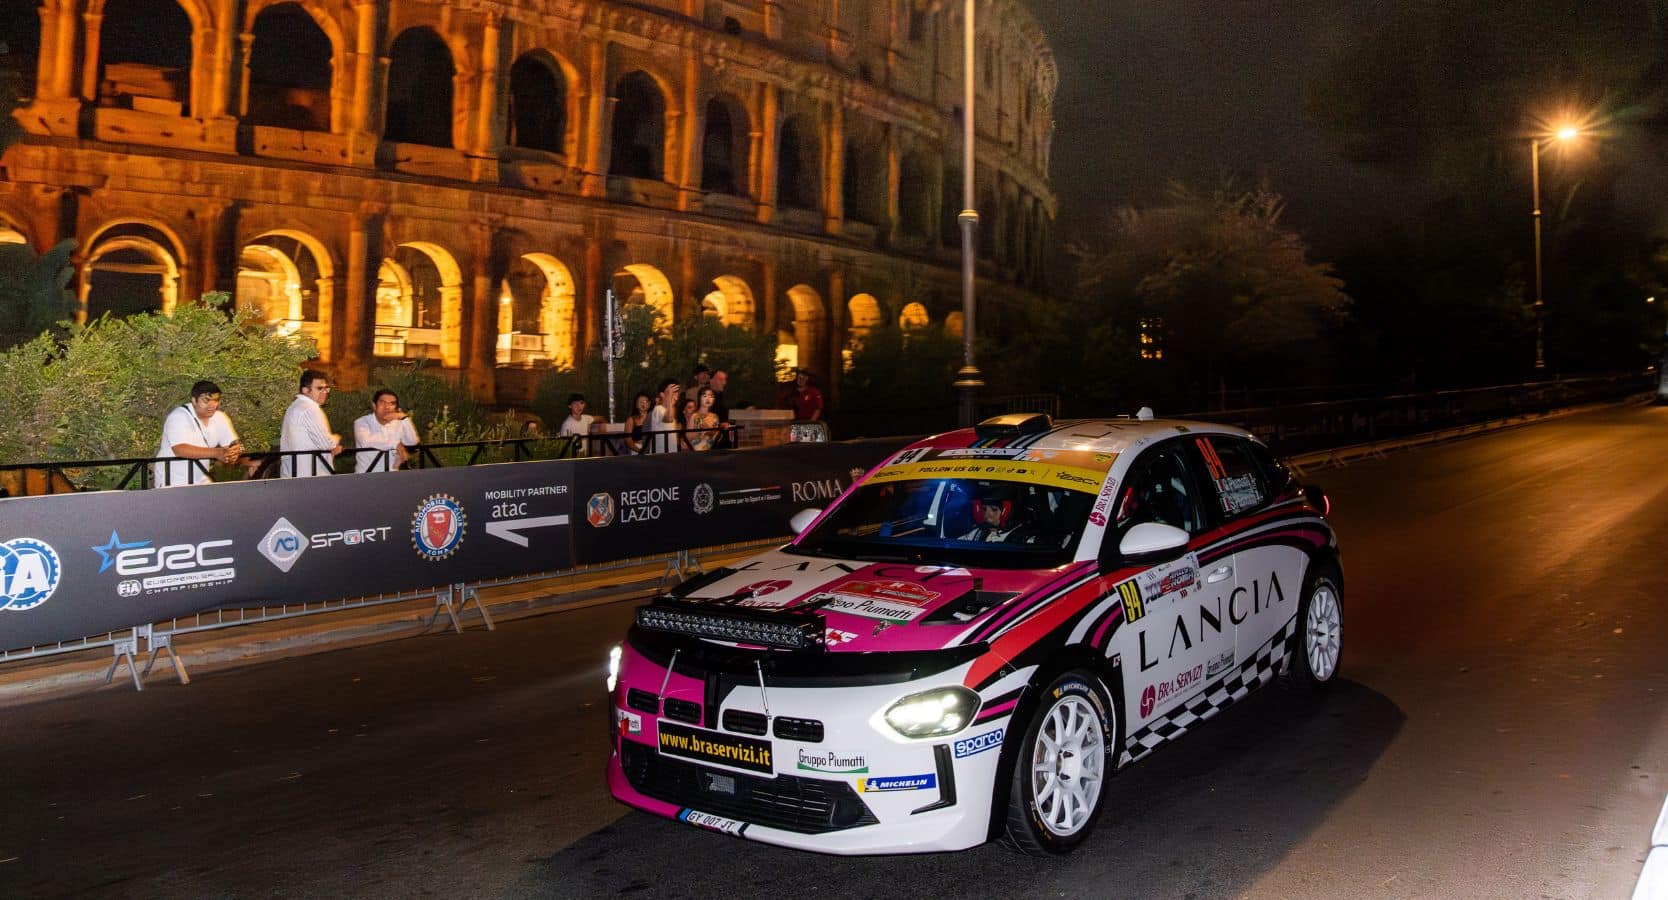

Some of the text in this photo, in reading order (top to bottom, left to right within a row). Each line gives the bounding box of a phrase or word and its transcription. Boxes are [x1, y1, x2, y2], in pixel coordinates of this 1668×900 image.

[485, 485, 568, 501] MOBILITY PARTNER
[620, 486, 680, 506] REGIONE
[791, 479, 843, 502] ROMA
[415, 499, 463, 533] AUTOMOBILE CLUB
[491, 502, 528, 518] atac
[620, 505, 661, 523] LAZIO
[274, 536, 299, 553] ACI
[311, 526, 392, 549] SPORT
[116, 539, 234, 576] ERC
[855, 600, 915, 620] Piumatti
[1119, 581, 1143, 622] 94
[1138, 570, 1285, 672] LANCIA
[1157, 679, 1175, 701] BRA
[1176, 664, 1203, 690] SERVIZI
[659, 731, 771, 766] www.braservizi.it
[956, 730, 1003, 754] sparco
[799, 748, 865, 768] Gruppo Piumatti
[879, 779, 928, 788] MICHELIN
[688, 811, 701, 822] GY
[703, 815, 720, 826] 007
